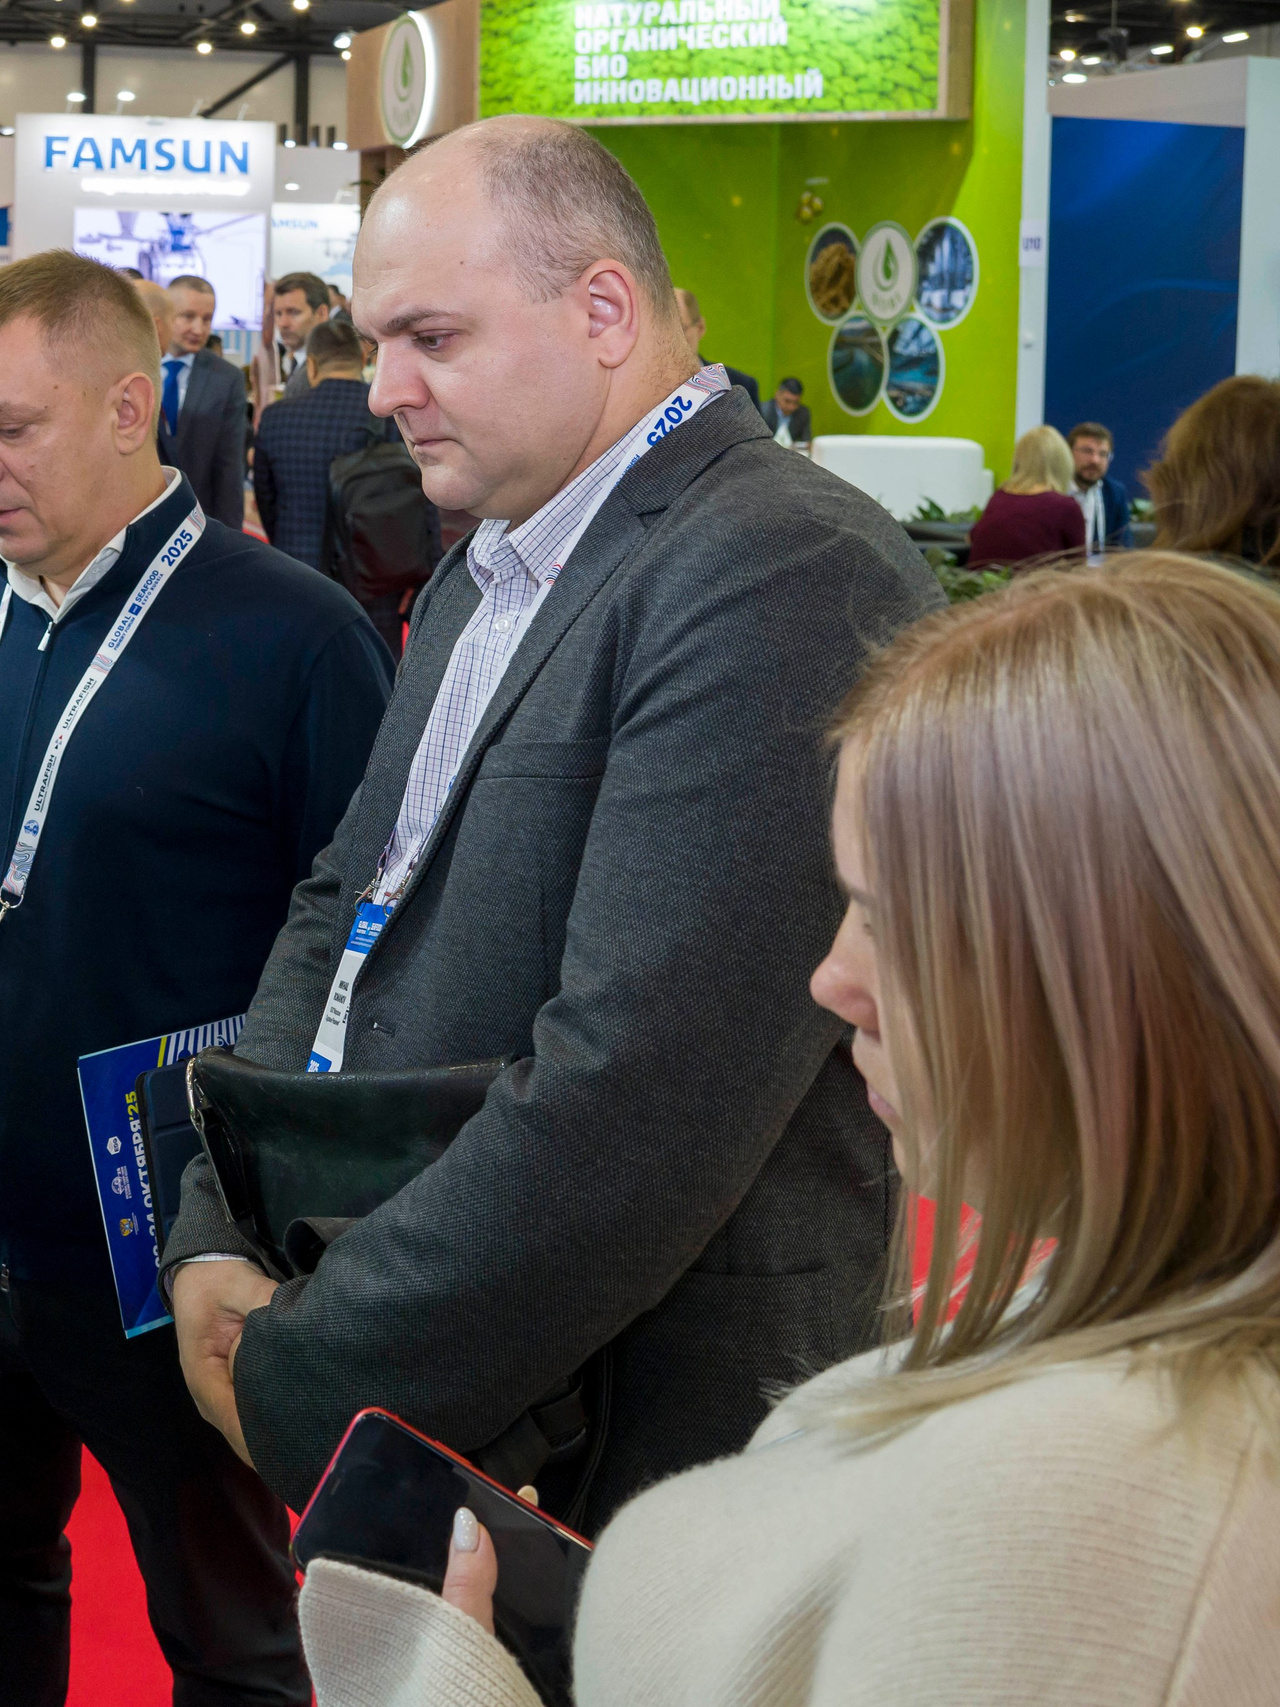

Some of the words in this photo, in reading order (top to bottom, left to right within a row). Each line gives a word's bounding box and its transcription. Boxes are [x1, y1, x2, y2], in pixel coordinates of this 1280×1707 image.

[574, 15, 788, 54] ОРГАНИЧЕСКИЙ
[574, 54, 628, 79] БИО
[574, 68, 823, 106] ИННОВАЦИОННЫЙ
[45, 136, 249, 174] FAMSUN
[647, 395, 693, 447] 2025
[161, 529, 193, 567] 2025
[142, 590, 152, 605] EXPO
[150, 573, 164, 592] RUSSIA
[108, 615, 132, 648] GLOBAL
[135, 570, 159, 602] SEAFOOD
[62, 677, 95, 729] ULTRAFISH
[34, 754, 55, 812] ULTRAFISH
